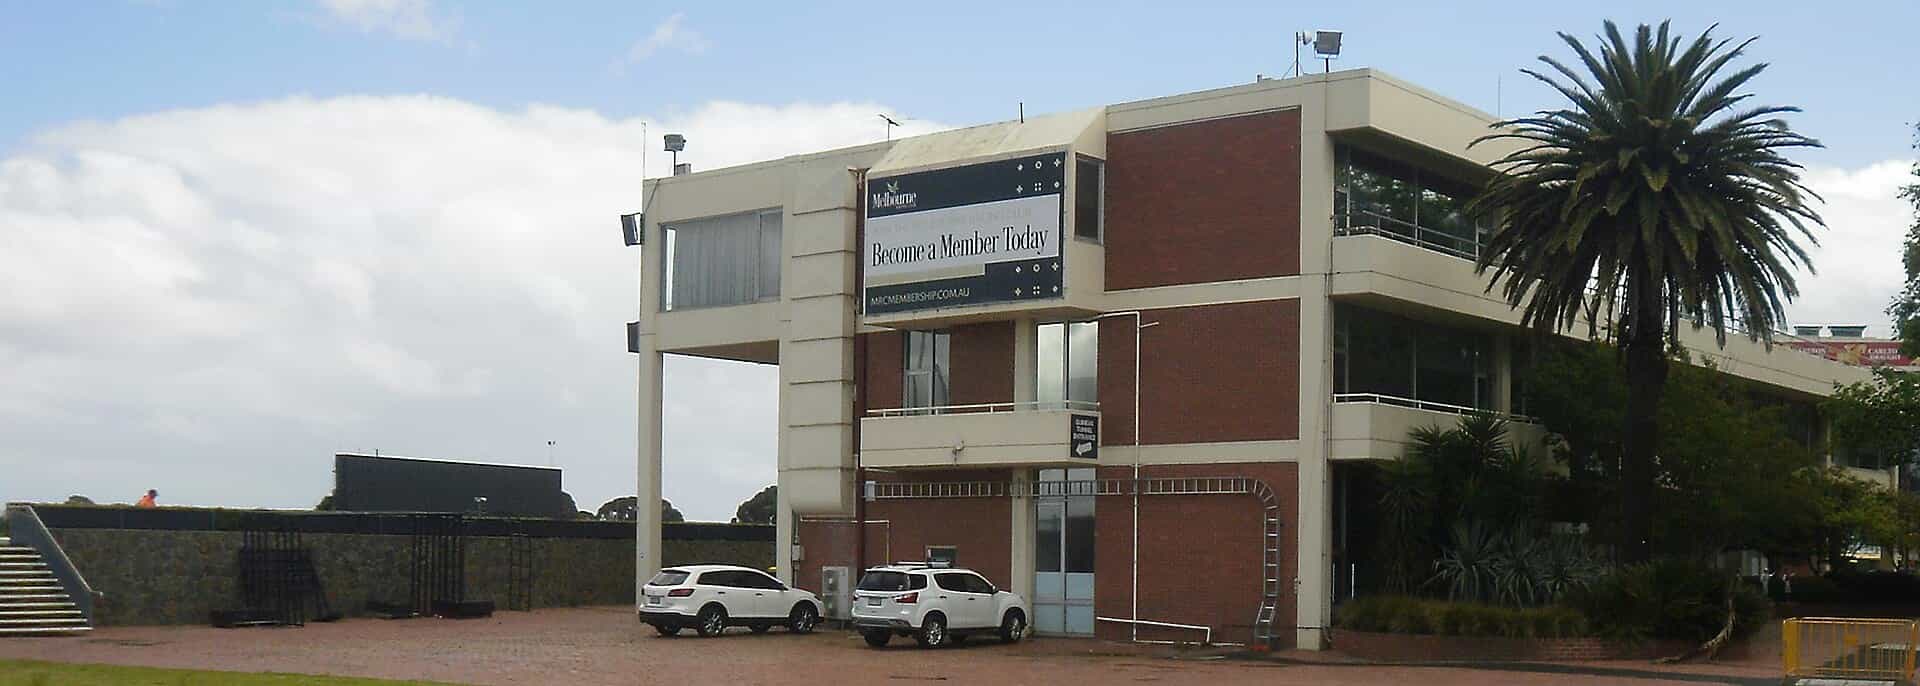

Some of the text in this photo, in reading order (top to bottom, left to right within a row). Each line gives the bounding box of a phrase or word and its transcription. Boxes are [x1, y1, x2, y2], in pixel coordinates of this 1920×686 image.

[872, 191, 917, 209] Melbourne
[872, 224, 1049, 267] Become a Member Today
